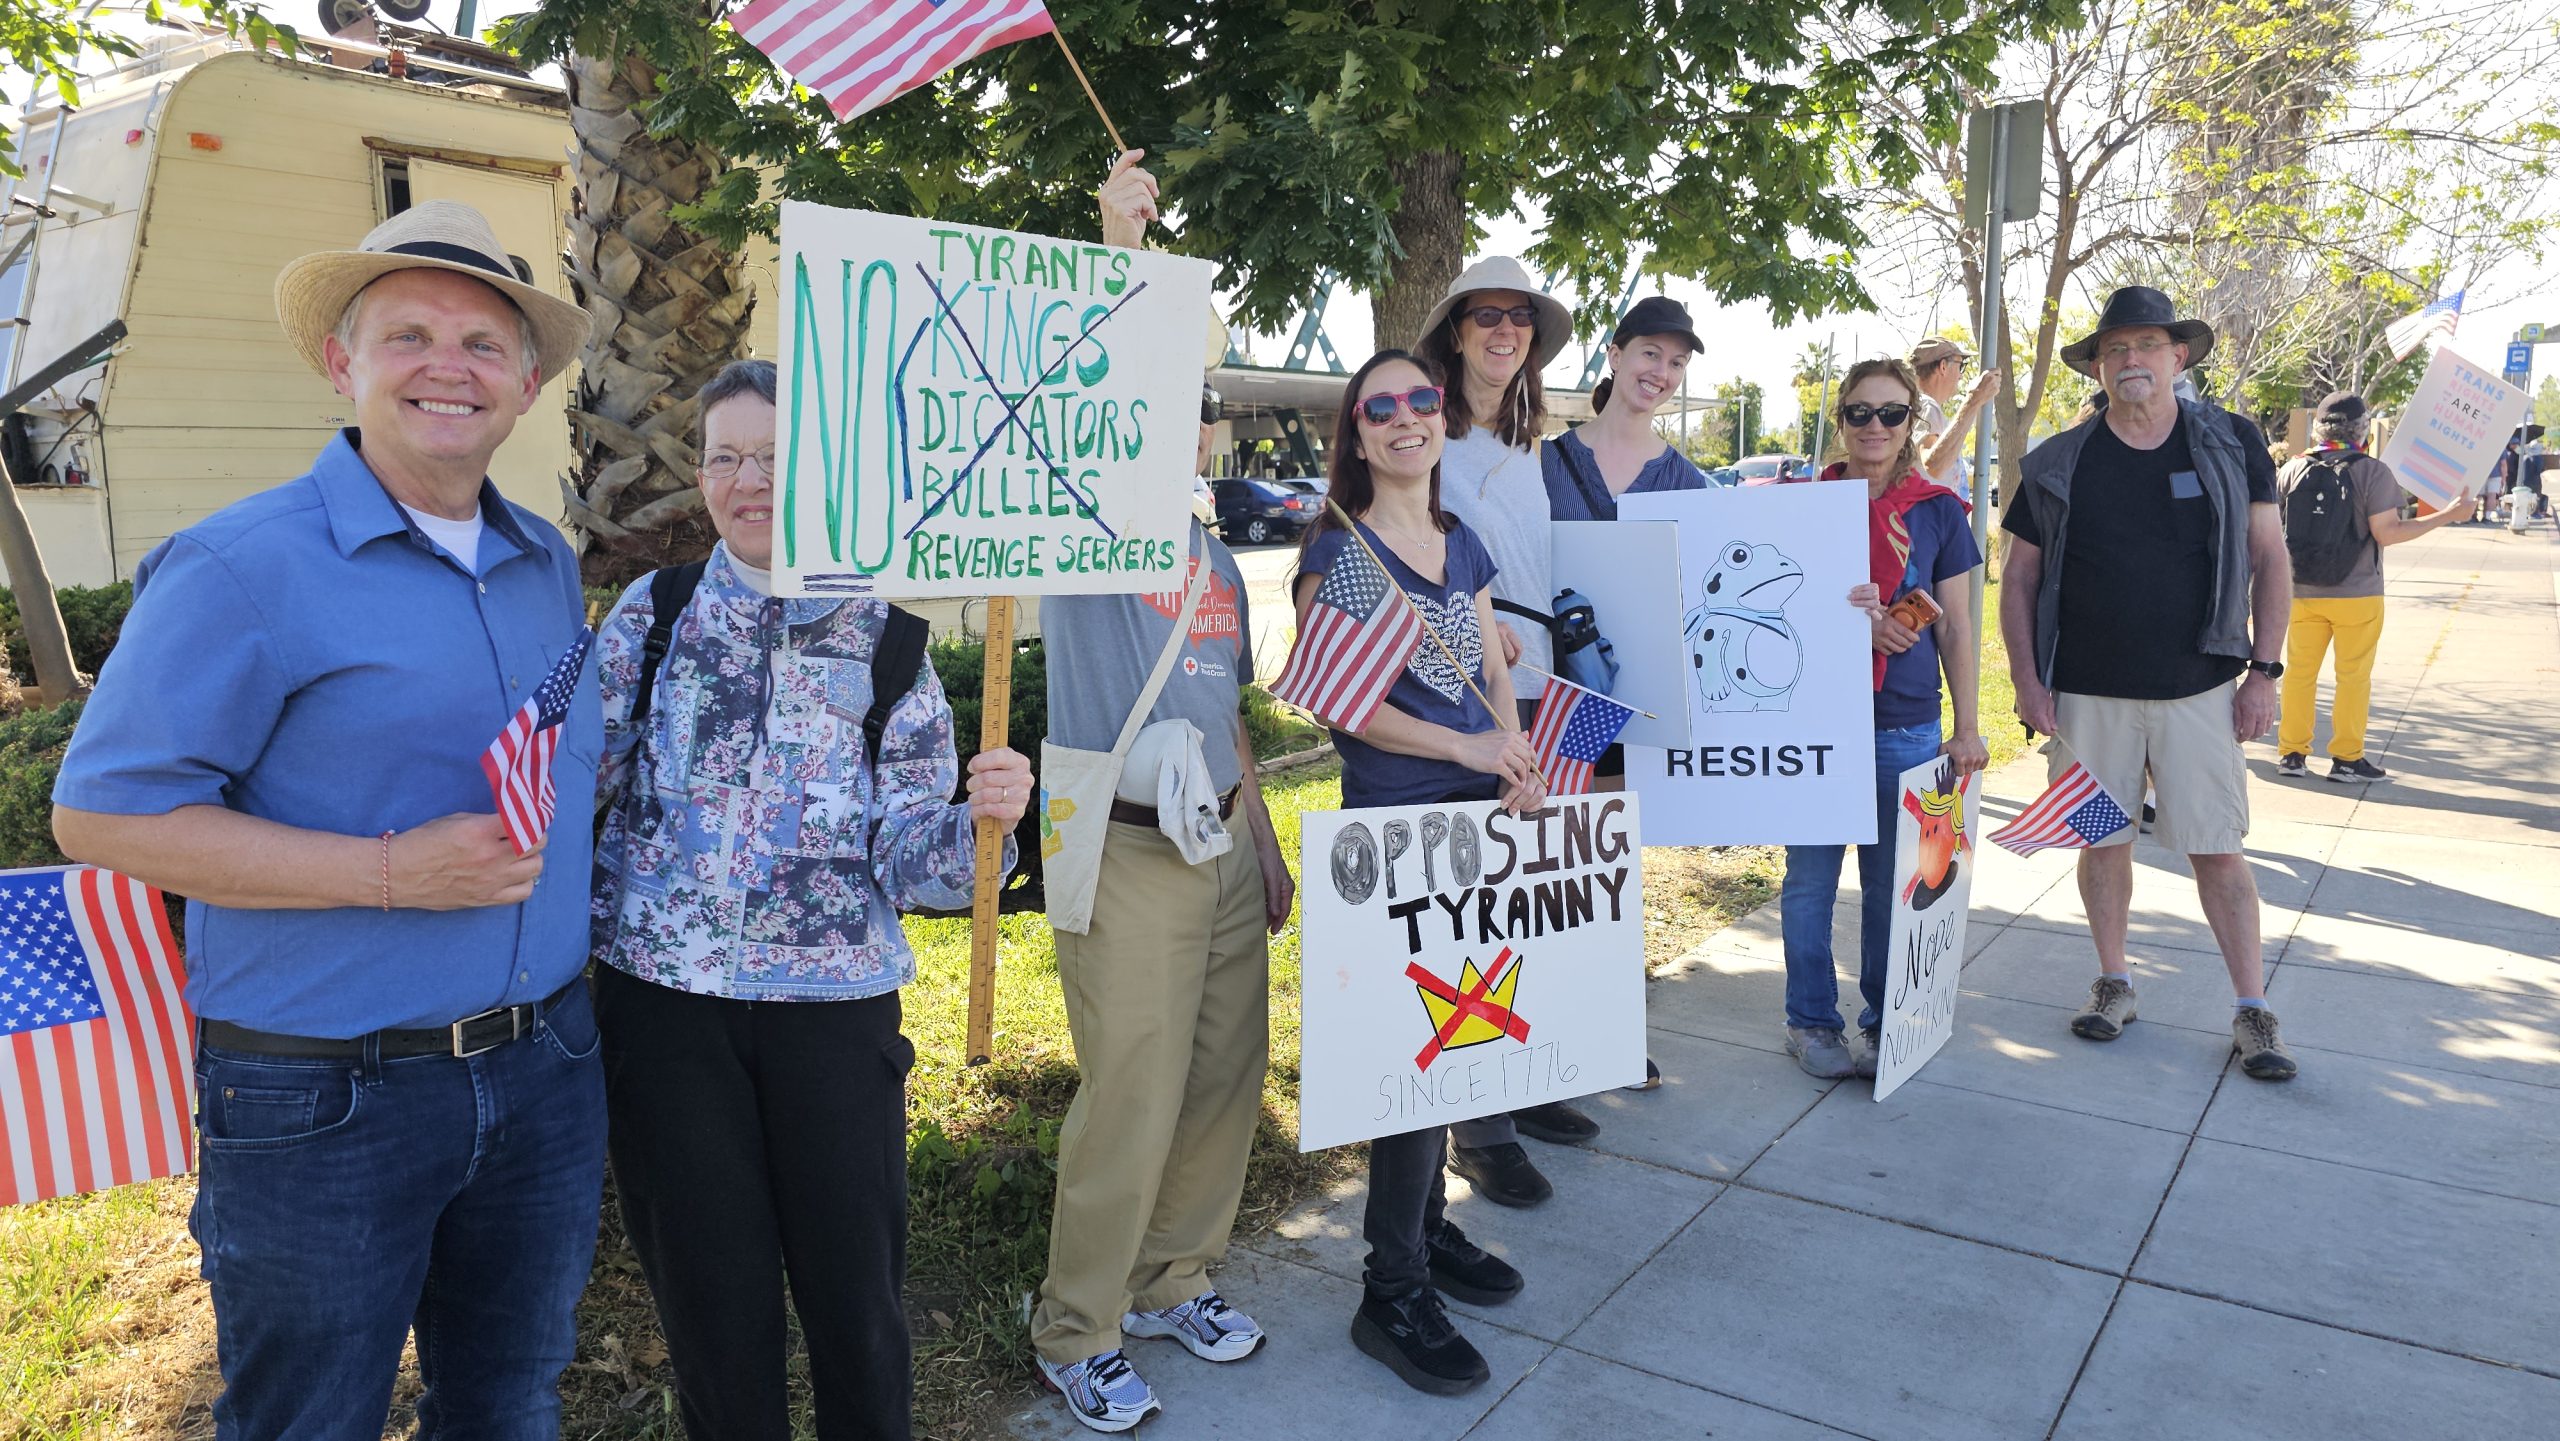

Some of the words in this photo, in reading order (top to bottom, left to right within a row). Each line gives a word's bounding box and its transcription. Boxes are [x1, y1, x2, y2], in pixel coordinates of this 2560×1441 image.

[929, 229, 1131, 296] TYRANTS
[931, 278, 1113, 387] KINGS
[2449, 378, 2497, 412] RIGHTS
[2451, 398, 2480, 420] ARE
[2454, 364, 2505, 401] TRANS
[784, 251, 898, 574] NO
[918, 387, 1148, 462] DICTATORS
[2430, 418, 2476, 450] RIGHTS
[2433, 402, 2486, 440] HUMAN
[922, 461, 1101, 518] BULLIES
[906, 530, 1046, 581] REVENGE
[1056, 533, 1175, 573] SEEKERS
[1190, 613, 1238, 634] AMERICA
[1667, 745, 1834, 777] RESIST
[1330, 798, 1631, 906] OPPOSING
[1387, 868, 1629, 955] TYRANNY
[1894, 911, 1956, 1011] Nope
[1373, 1061, 1487, 1121] SINCE
[1501, 1041, 1579, 1098] 1776
